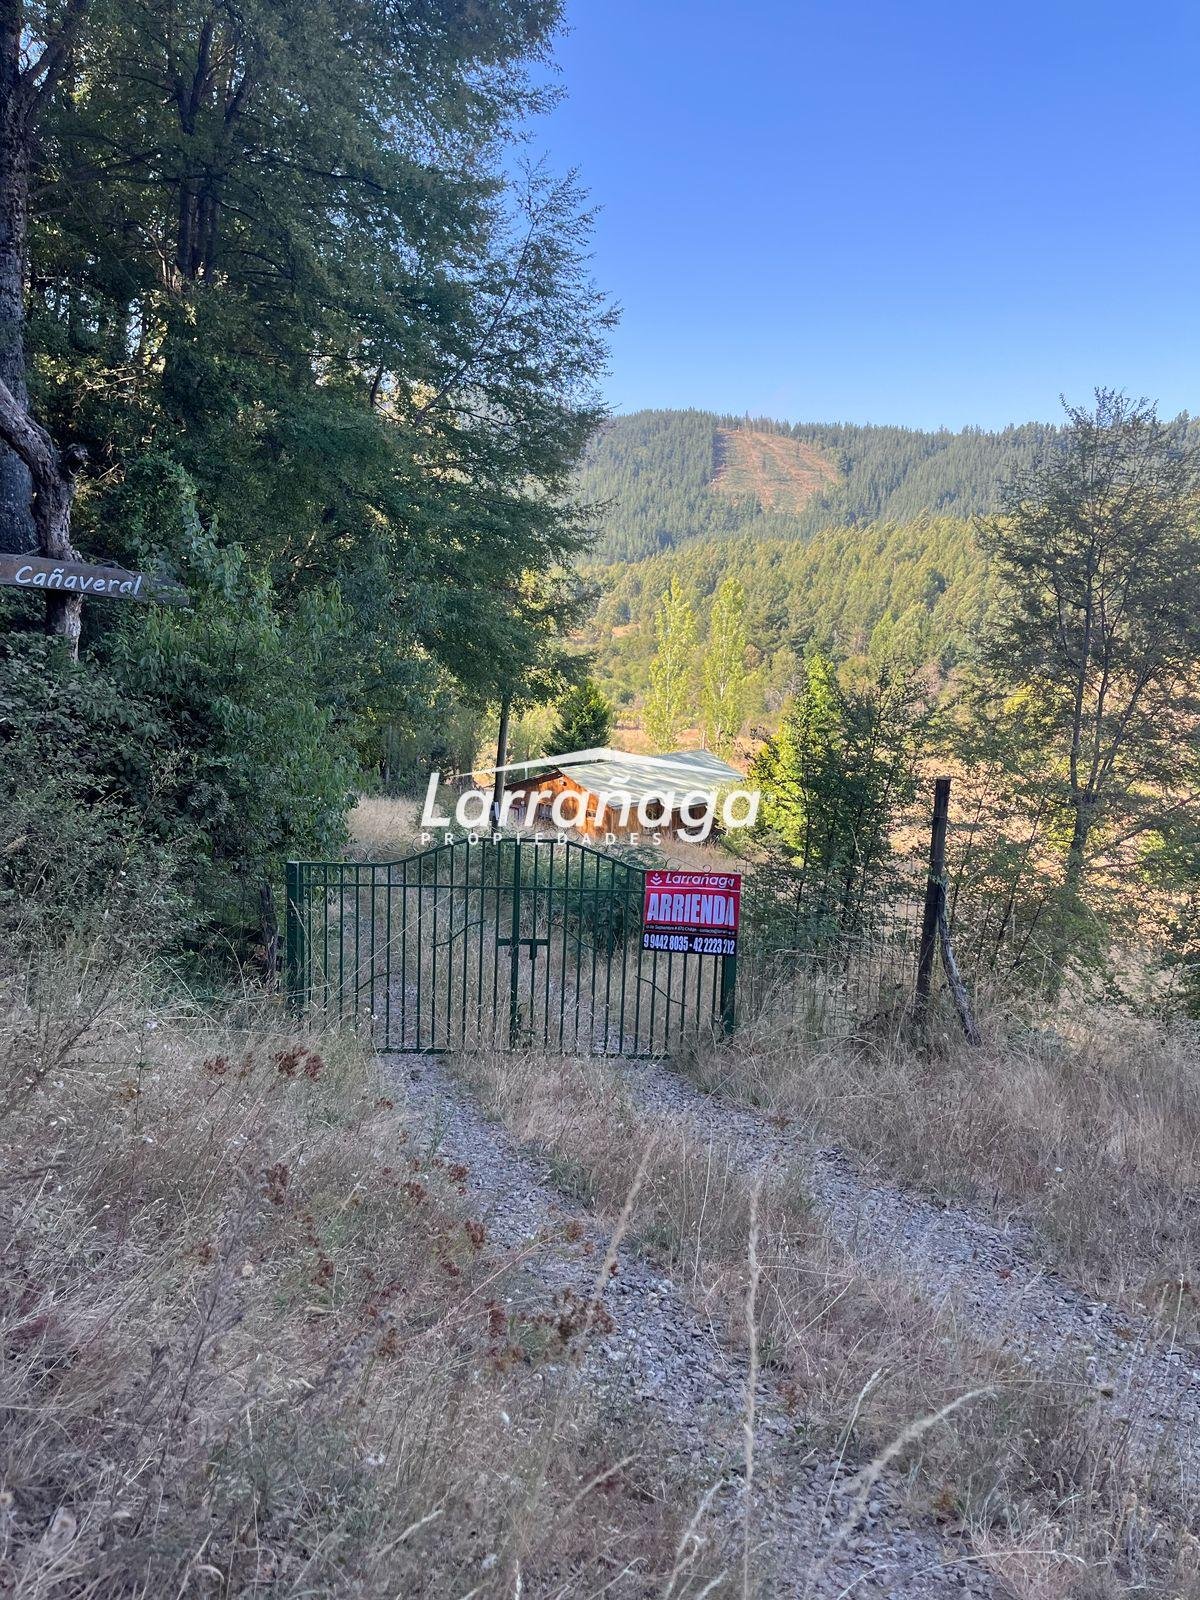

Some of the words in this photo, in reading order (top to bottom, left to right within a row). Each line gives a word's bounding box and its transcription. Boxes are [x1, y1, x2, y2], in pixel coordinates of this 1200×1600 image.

[15, 565, 142, 595] Cañaveral
[665, 873, 735, 888] Larrañaga
[647, 893, 735, 926] ARRIENDA
[644, 933, 649, 948] 9
[650, 934, 668, 949] 9442
[669, 935, 689, 951] 8035
[693, 937, 703, 952] 42
[703, 938, 722, 954] 2223
